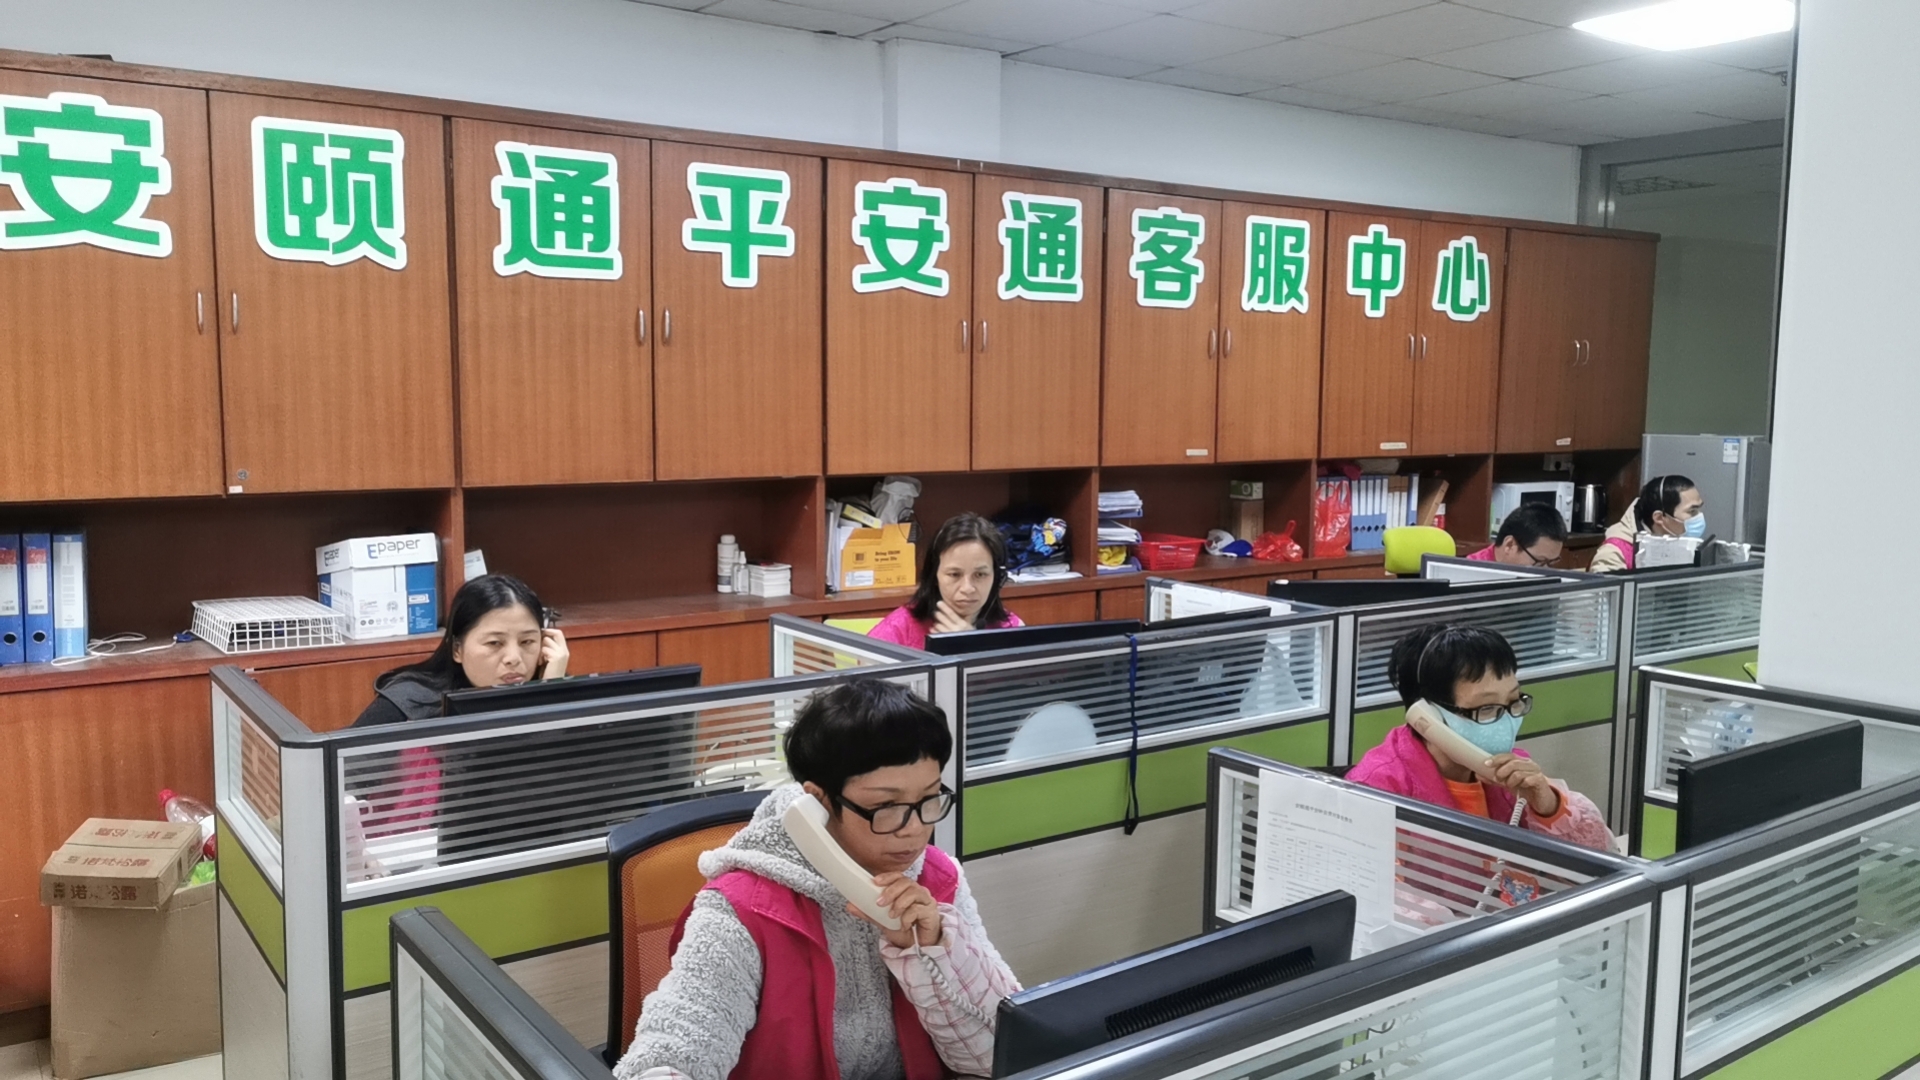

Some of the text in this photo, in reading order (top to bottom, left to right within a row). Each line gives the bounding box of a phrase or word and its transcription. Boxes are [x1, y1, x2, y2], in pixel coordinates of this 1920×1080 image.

[0, 98, 1488, 318] 安颐通平安通客服中心
[366, 539, 421, 559] Epaper
